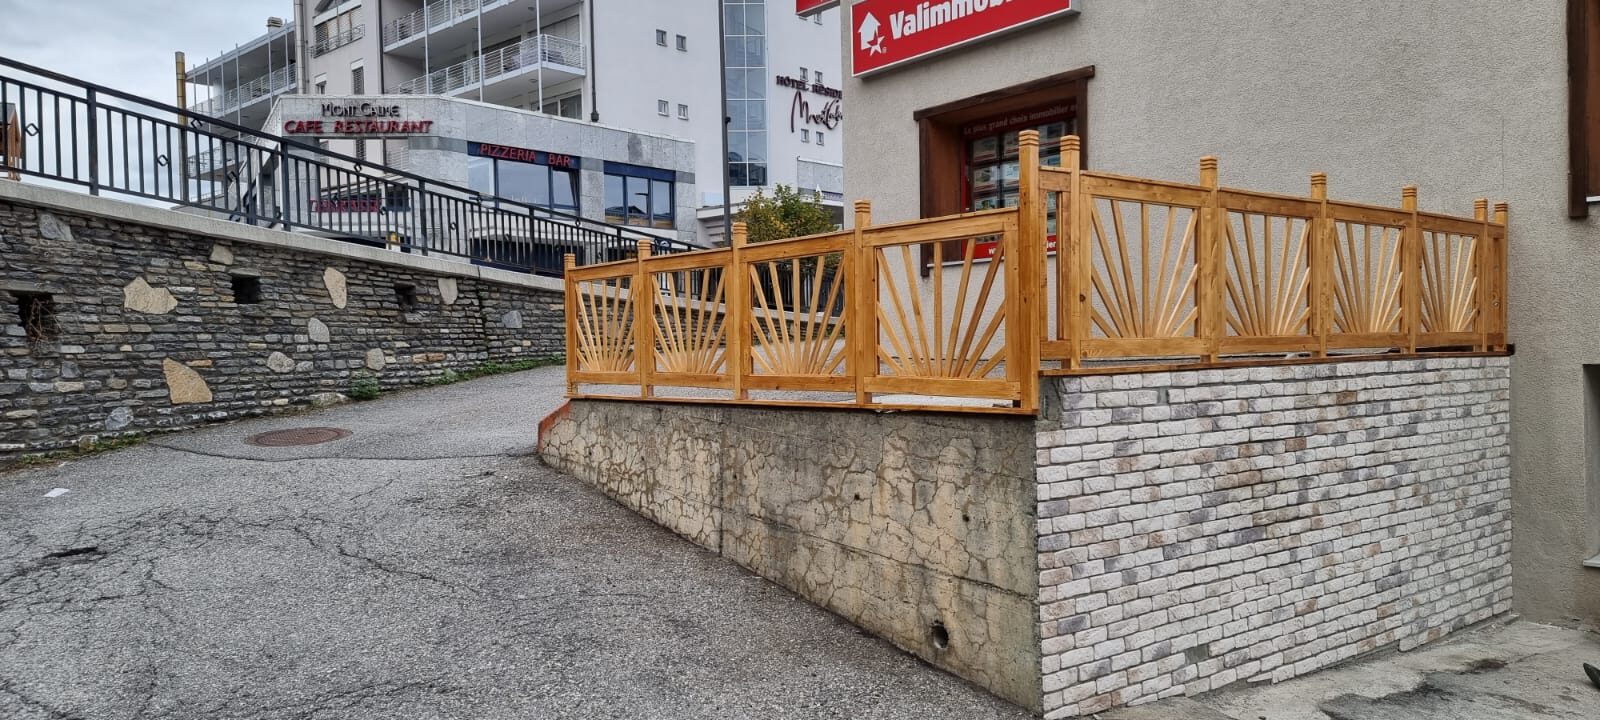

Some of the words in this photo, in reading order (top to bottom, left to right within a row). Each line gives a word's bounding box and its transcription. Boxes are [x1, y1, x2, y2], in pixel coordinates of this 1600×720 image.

[334, 120, 433, 134] RESTAURANT
[988, 117, 1008, 131] grand
[480, 143, 536, 163] PIZZERIA
[548, 153, 571, 167] BAR
